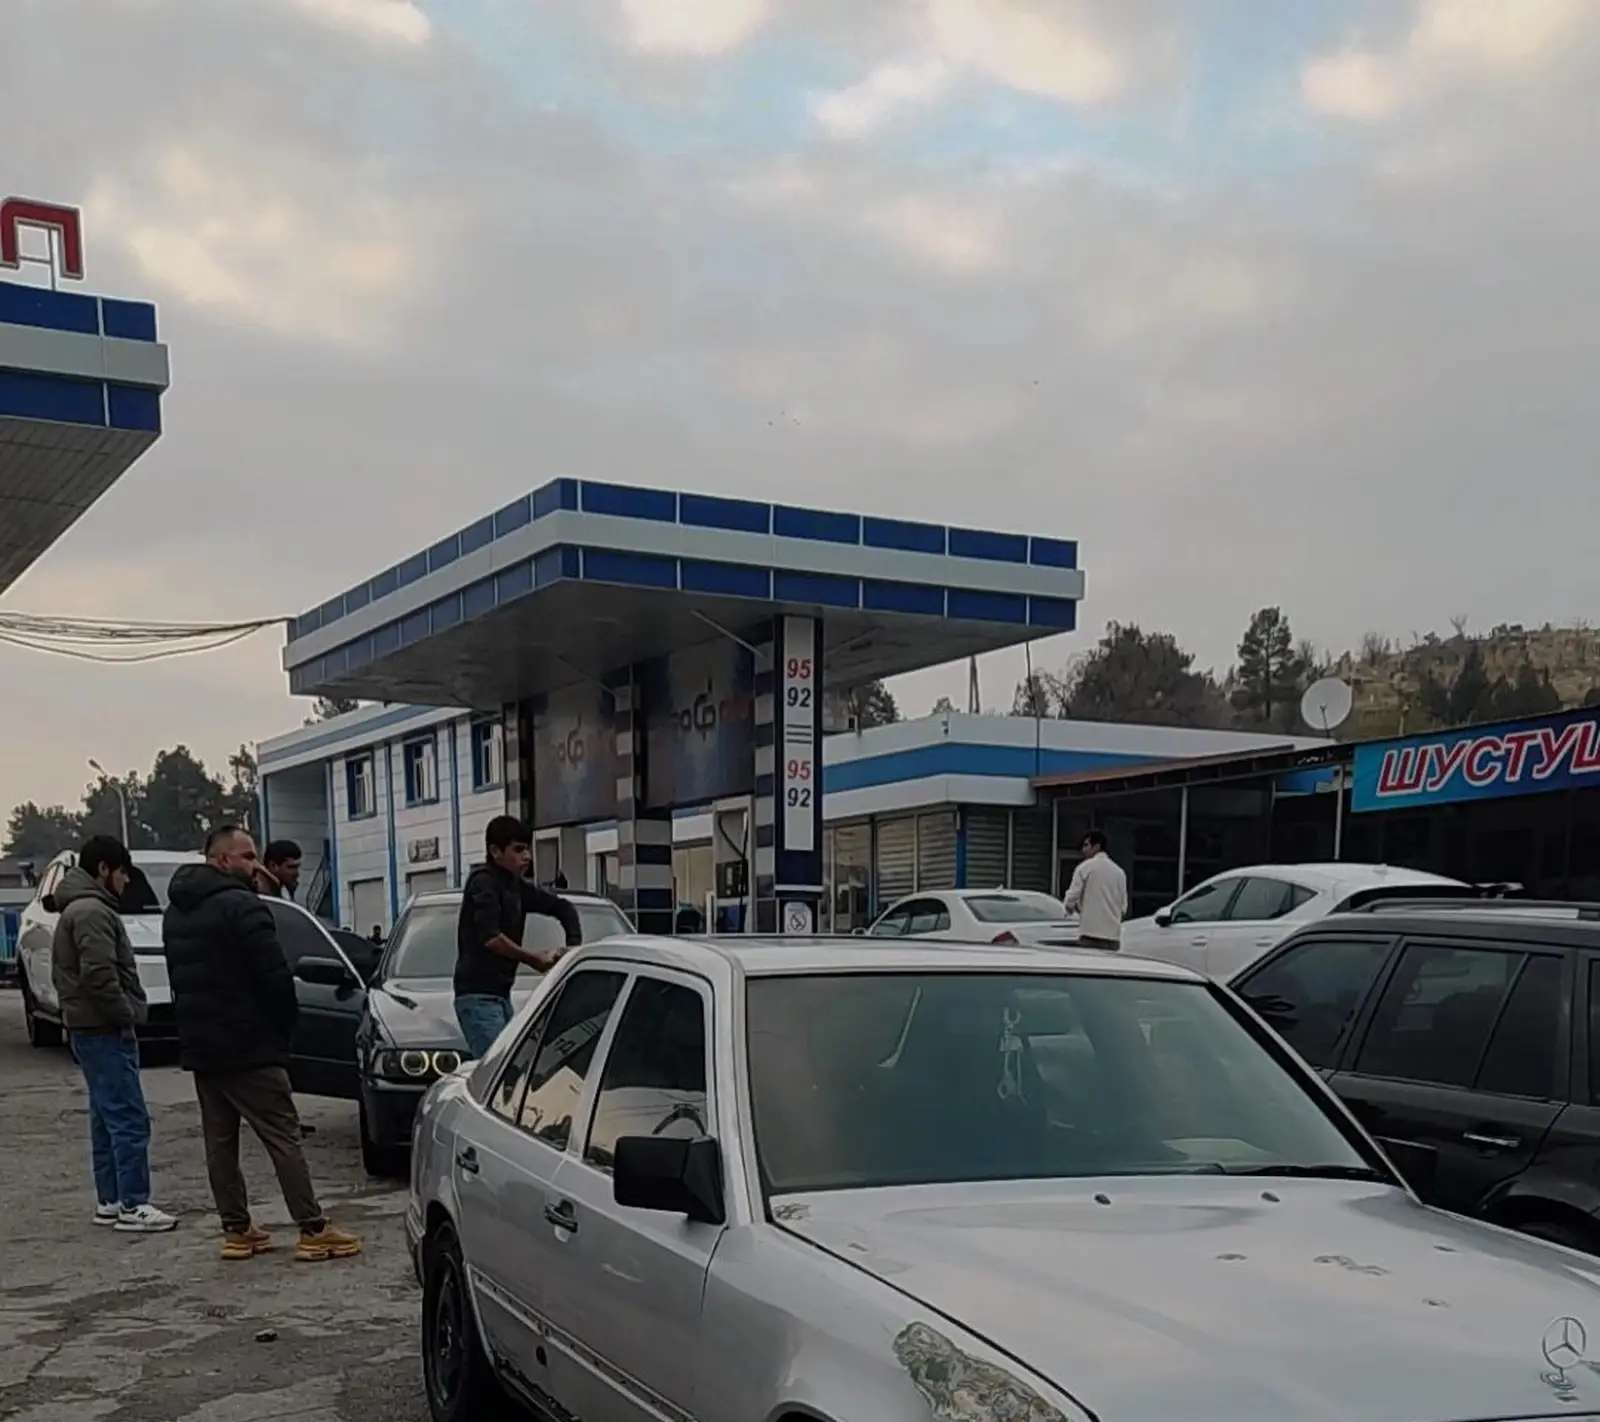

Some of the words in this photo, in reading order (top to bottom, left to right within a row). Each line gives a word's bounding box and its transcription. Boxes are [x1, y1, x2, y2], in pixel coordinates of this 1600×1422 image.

[787, 658, 812, 679] 95
[787, 687, 812, 707] 92
[787, 760, 811, 780] 95
[787, 788, 811, 808] 92
